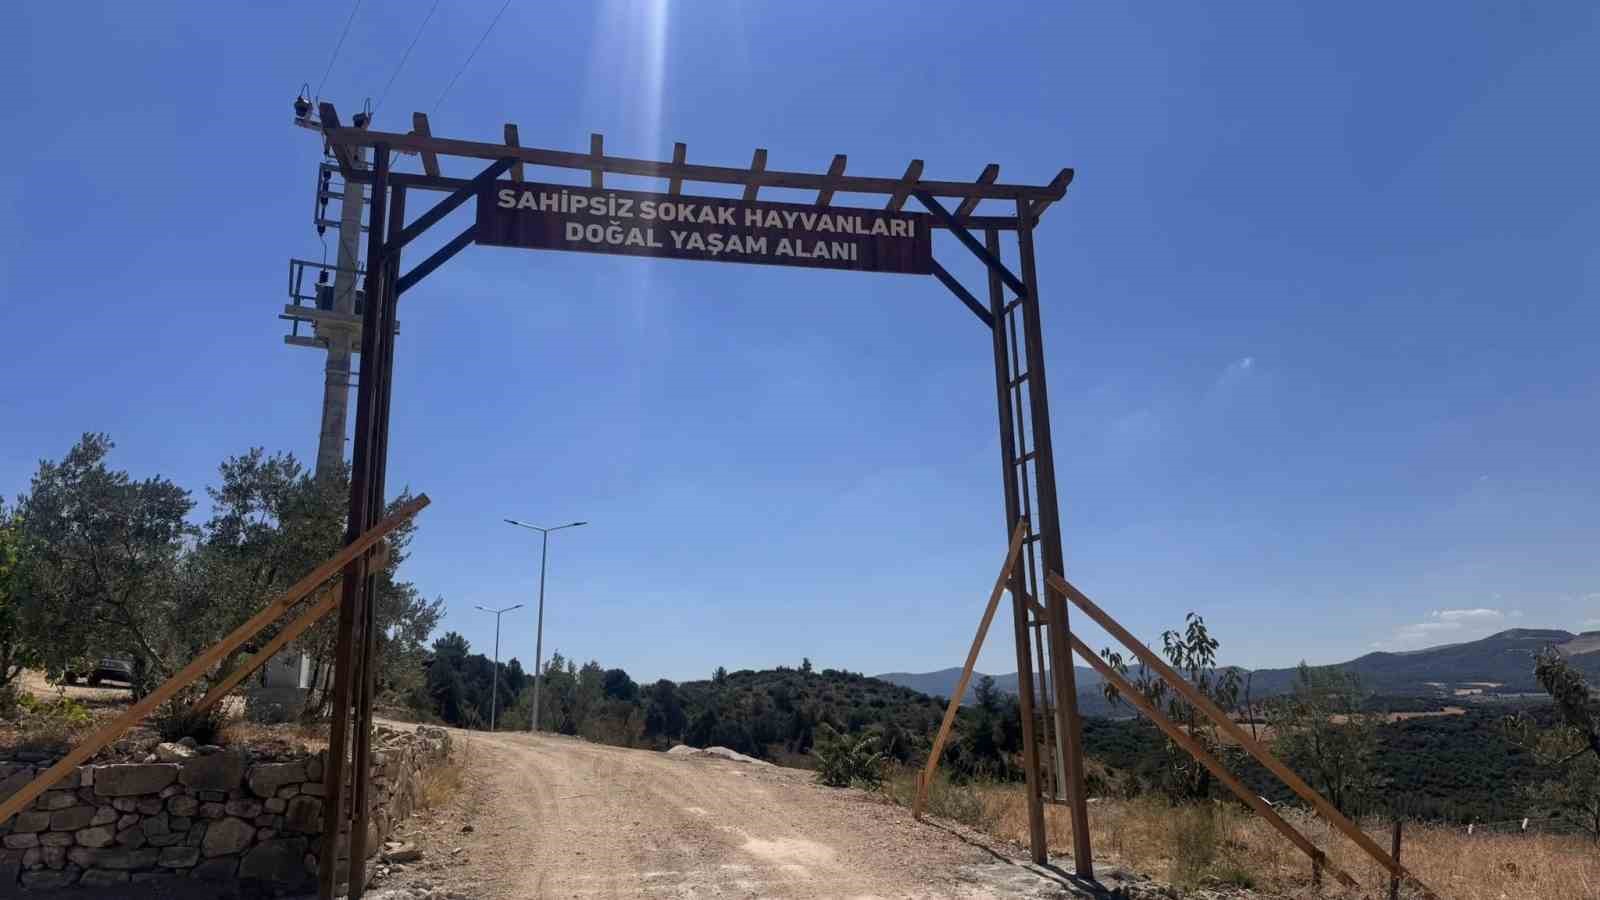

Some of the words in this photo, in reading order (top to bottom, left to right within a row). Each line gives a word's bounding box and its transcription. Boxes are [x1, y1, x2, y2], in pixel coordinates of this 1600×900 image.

[497, 188, 633, 218] SAHİPSİZ
[639, 201, 737, 226] SOKAK
[744, 209, 915, 238] HAYVANLARI
[565, 220, 662, 248] DOĞAL
[670, 229, 767, 256] YAŞAM
[774, 238, 858, 261] ALANI
